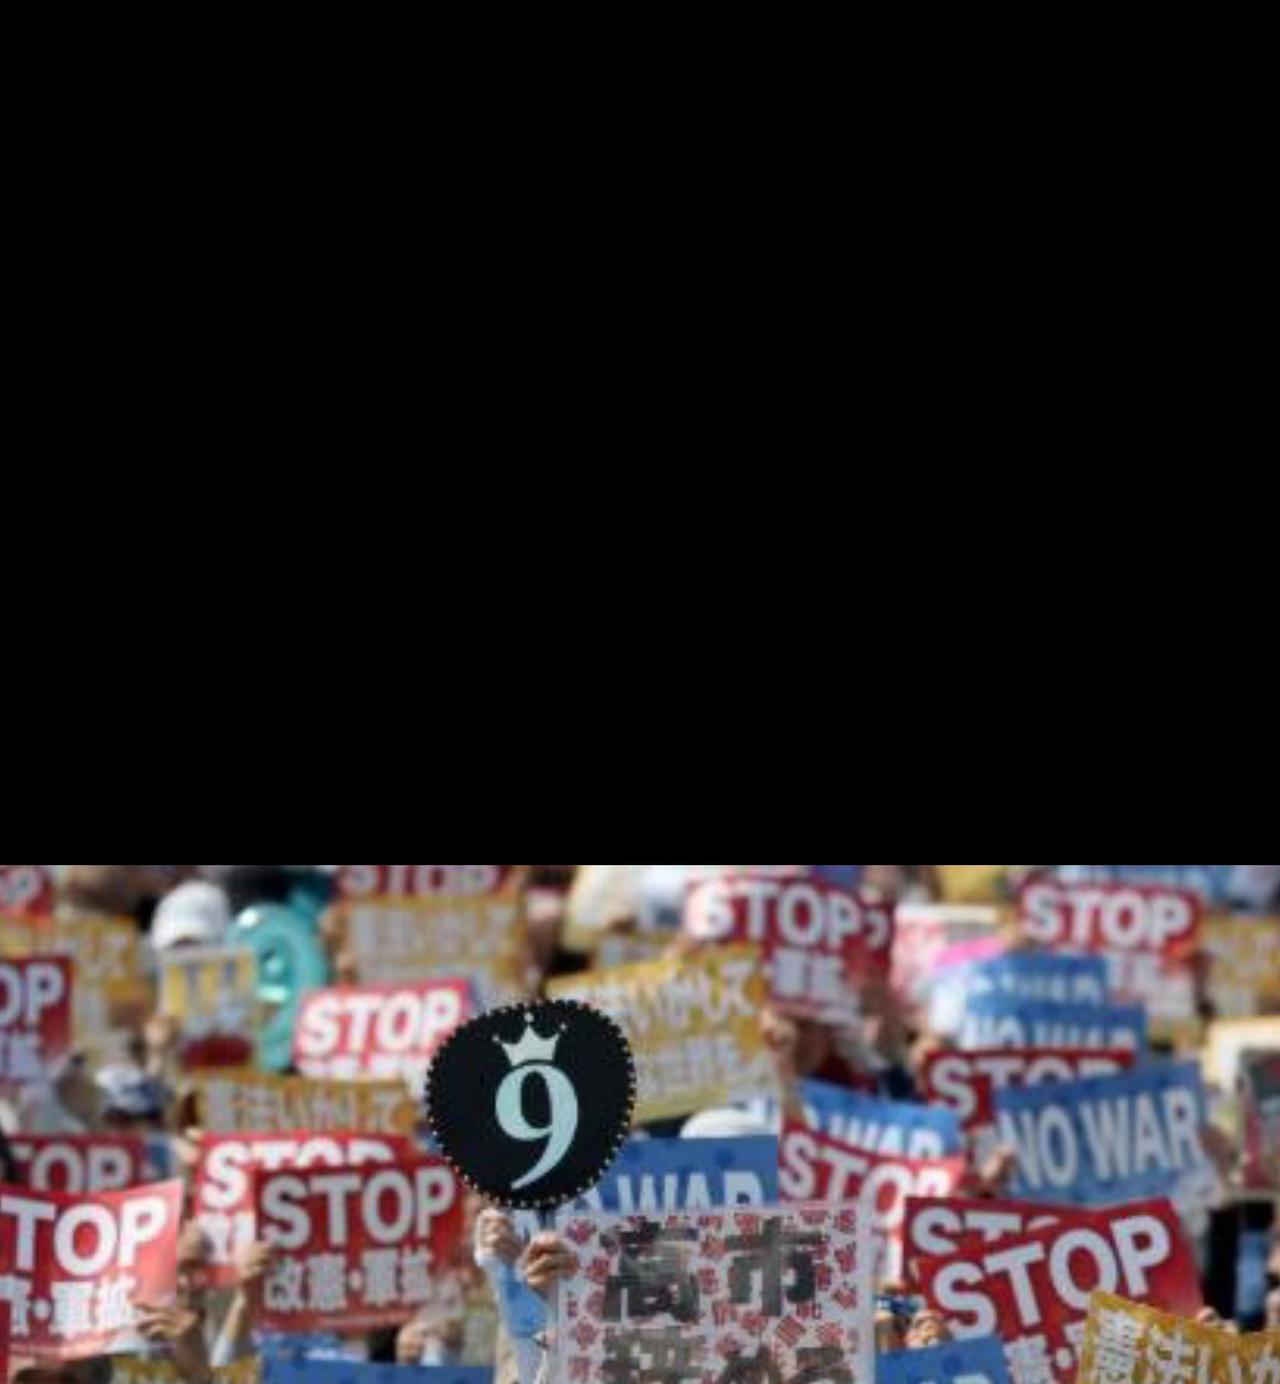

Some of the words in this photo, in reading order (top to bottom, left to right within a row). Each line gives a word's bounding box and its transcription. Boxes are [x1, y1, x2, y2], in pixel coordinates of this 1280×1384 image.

[685, 881, 860, 946] STOP
[1021, 885, 1192, 945] STOP
[299, 987, 463, 1056] STOP
[495, 1062, 579, 1190] 9
[1001, 1105, 1078, 1189] NO
[1082, 1086, 1199, 1181] WAR
[261, 1166, 455, 1250] STOP
[911, 1206, 1061, 1256] ST
[600, 1216, 824, 1324] 高市
[933, 1214, 1172, 1341] STOP
